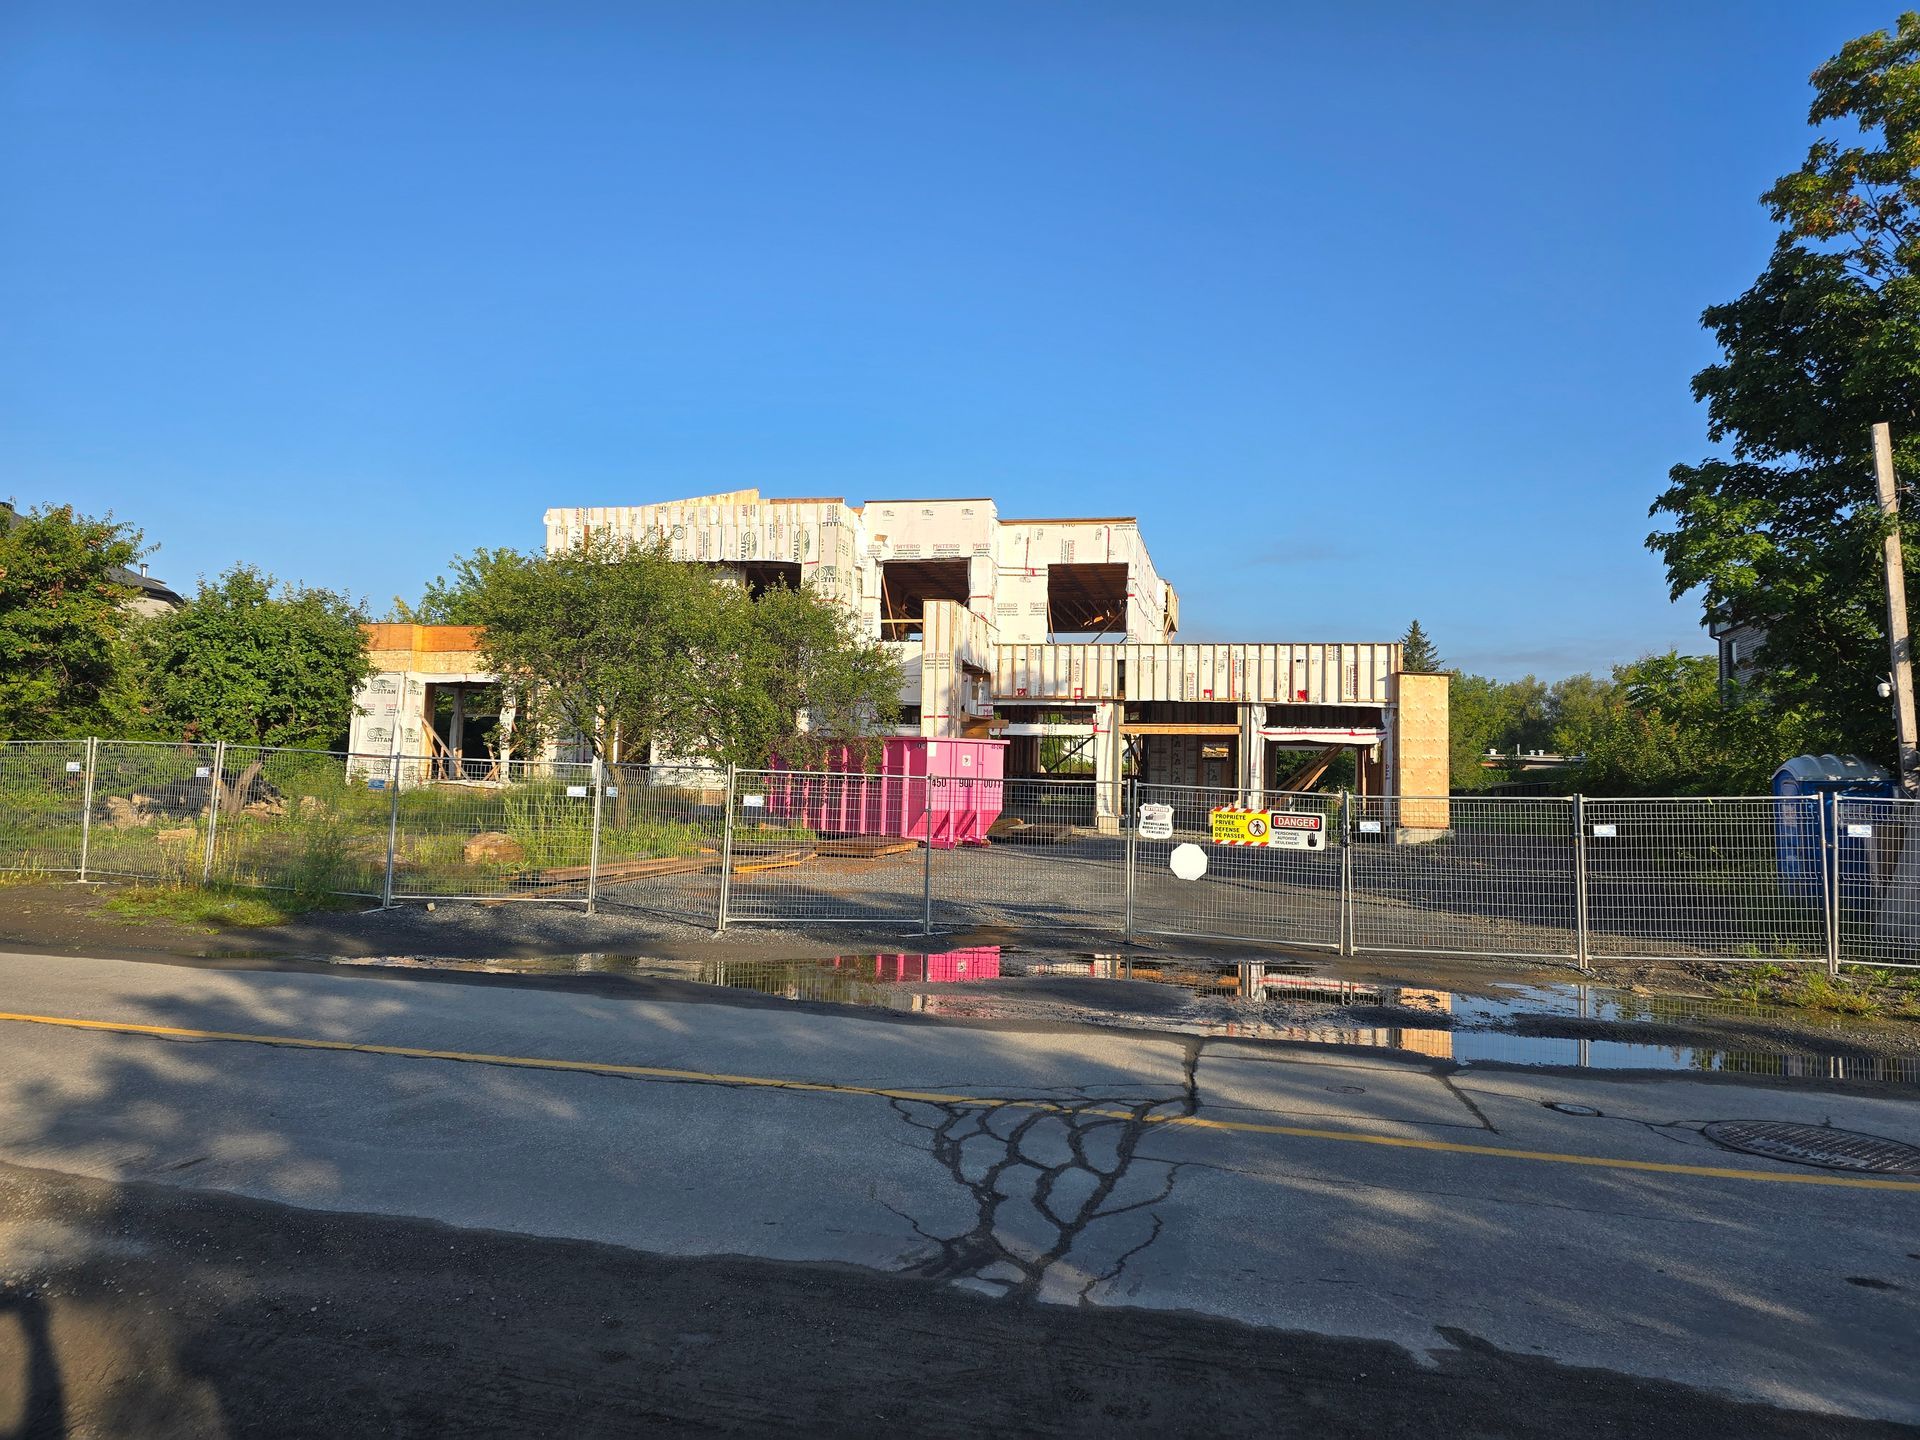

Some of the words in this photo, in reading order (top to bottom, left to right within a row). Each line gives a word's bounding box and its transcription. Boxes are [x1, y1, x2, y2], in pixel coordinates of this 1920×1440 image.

[933, 543, 960, 551] MATERIO
[932, 778, 947, 787] 450
[1278, 817, 1315, 828] DANGER
